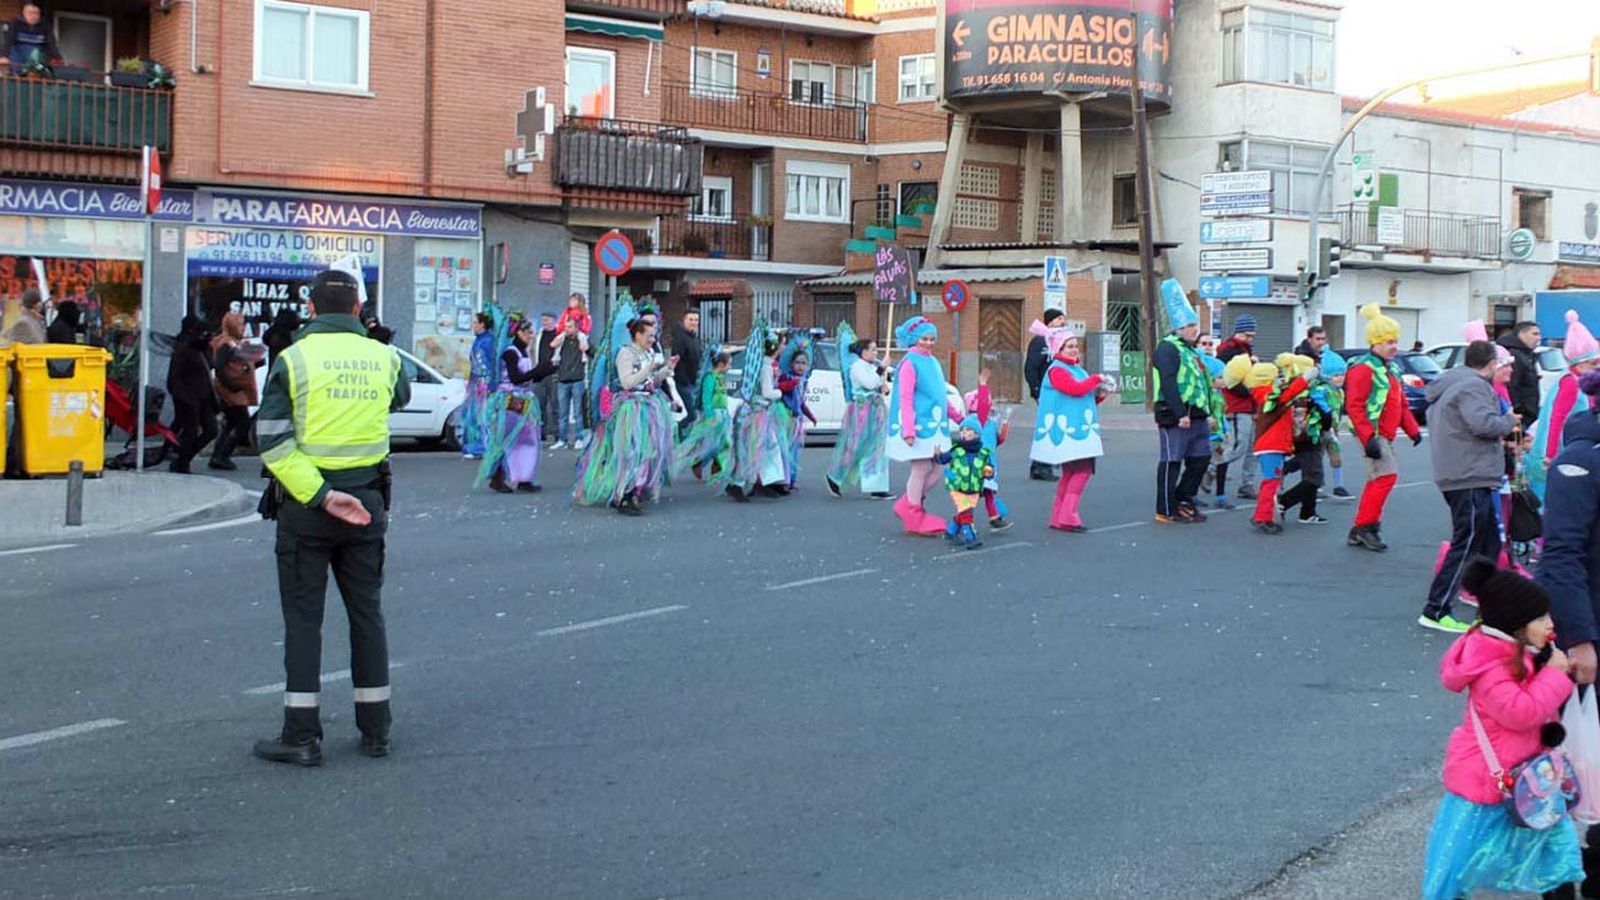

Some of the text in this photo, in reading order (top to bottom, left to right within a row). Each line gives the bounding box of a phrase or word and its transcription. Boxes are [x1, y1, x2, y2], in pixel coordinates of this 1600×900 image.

[987, 14, 1132, 45] GIMNASIO
[987, 44, 1133, 67] PARACUELLOS
[991, 73, 1011, 84] 658
[1014, 72, 1027, 83] 16
[1030, 72, 1045, 83] 04
[1067, 73, 1110, 85] Antonia
[0, 185, 192, 215] RMACIA Bienstar
[213, 198, 478, 232] PARAFARMACIA Bienestar
[195, 230, 271, 249] SERVICIO
[277, 234, 287, 249] A
[293, 235, 375, 254] DOMICILIO
[876, 247, 894, 266] LAS
[875, 260, 907, 290] PAVAS
[229, 300, 262, 317] SAN
[323, 360, 381, 371] GUARDIA
[337, 373, 369, 386] CIVIL
[326, 388, 379, 400] TRAFICO
